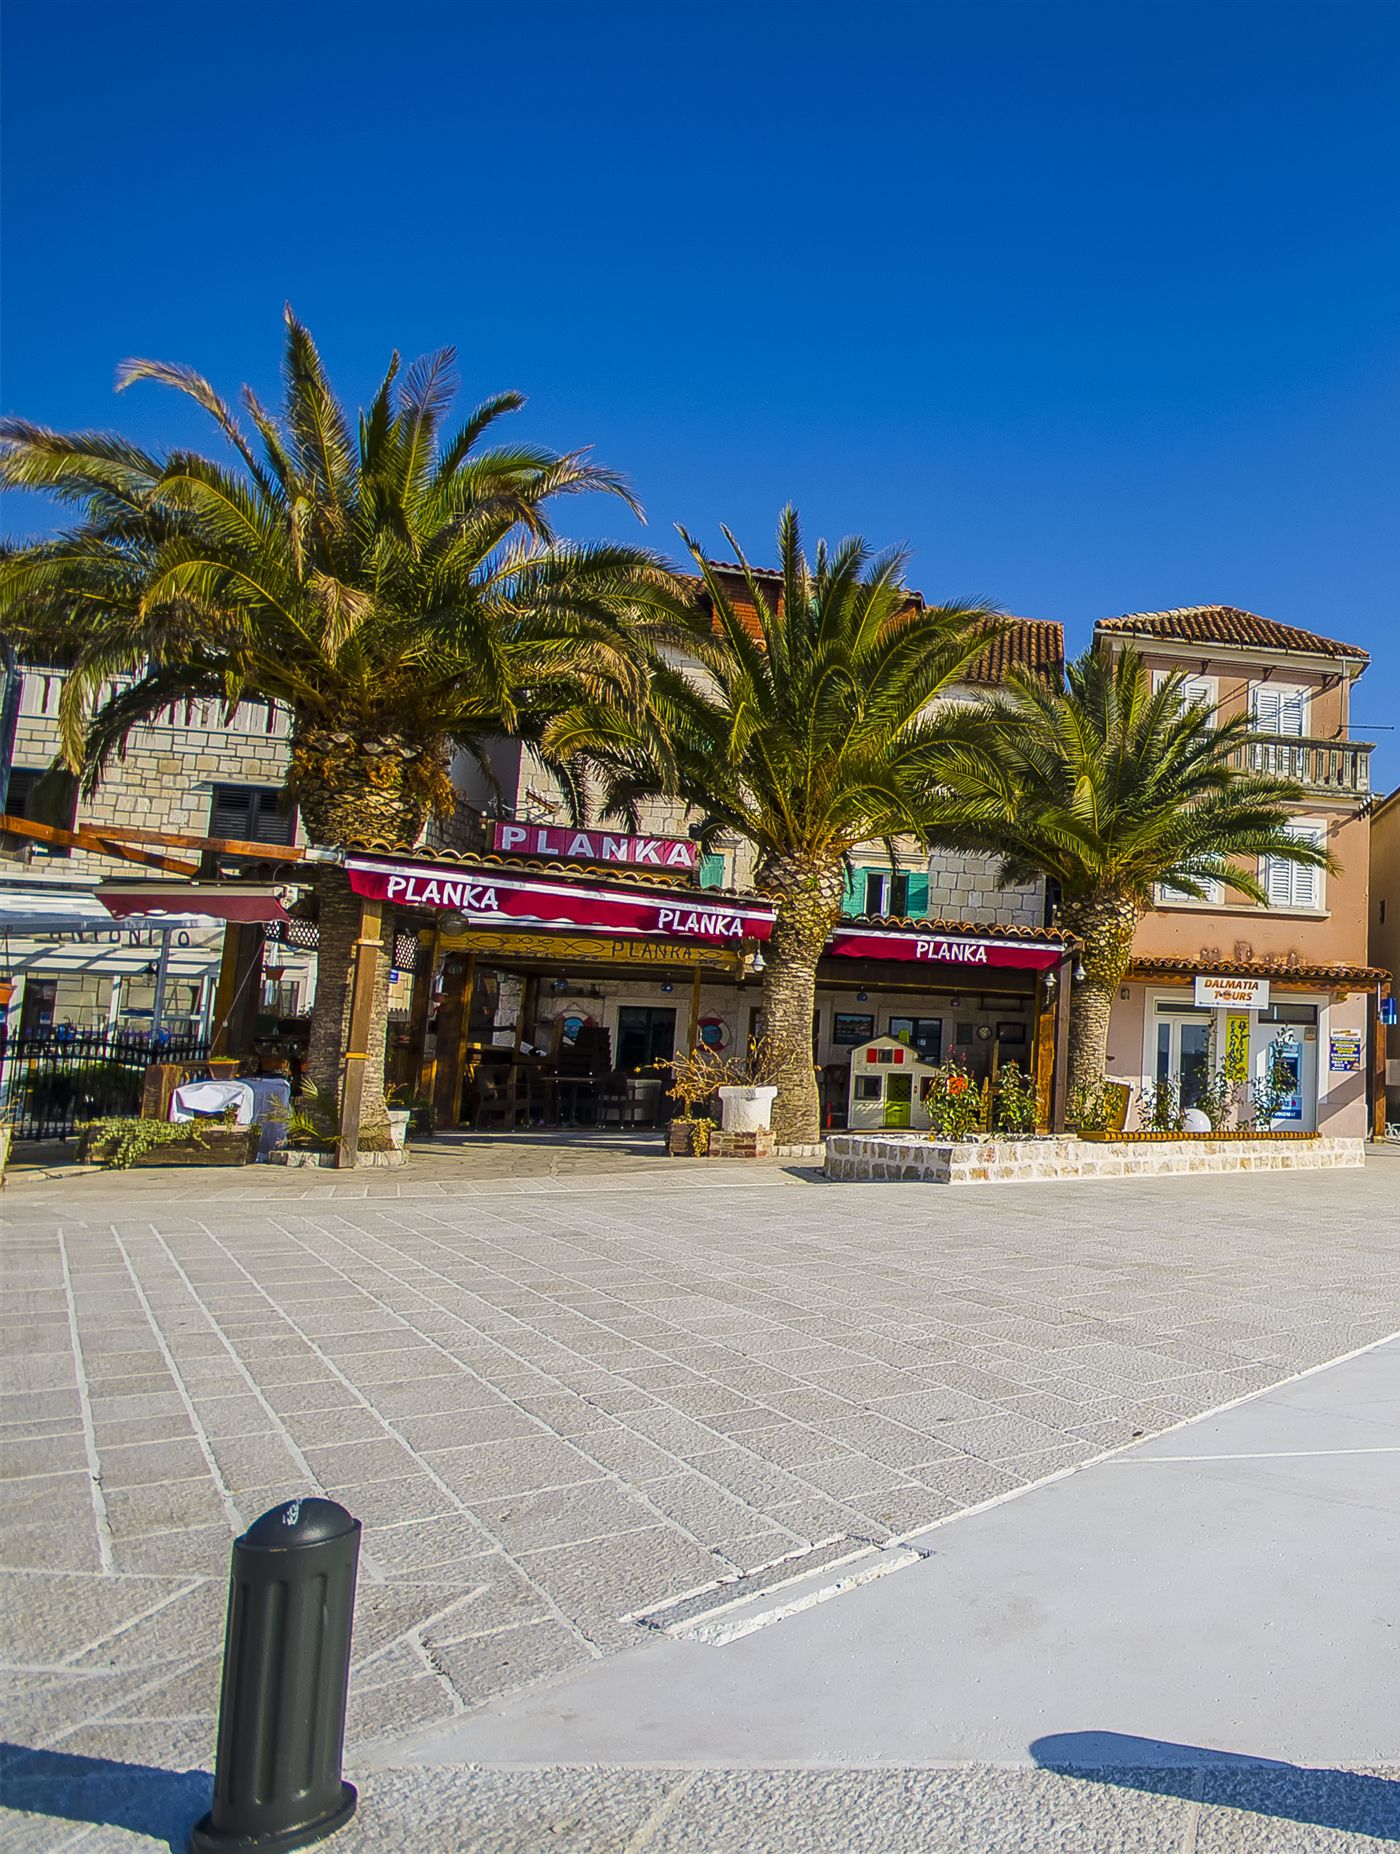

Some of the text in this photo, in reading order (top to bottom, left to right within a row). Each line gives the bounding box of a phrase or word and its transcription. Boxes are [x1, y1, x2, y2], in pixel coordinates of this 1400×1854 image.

[501, 826, 694, 867] PLANKA
[386, 875, 499, 912] PLANKA
[658, 909, 744, 937] PLANKA
[612, 940, 692, 960] PLANKA
[916, 941, 988, 963] PLANKA
[1204, 978, 1259, 990] DALMATIA
